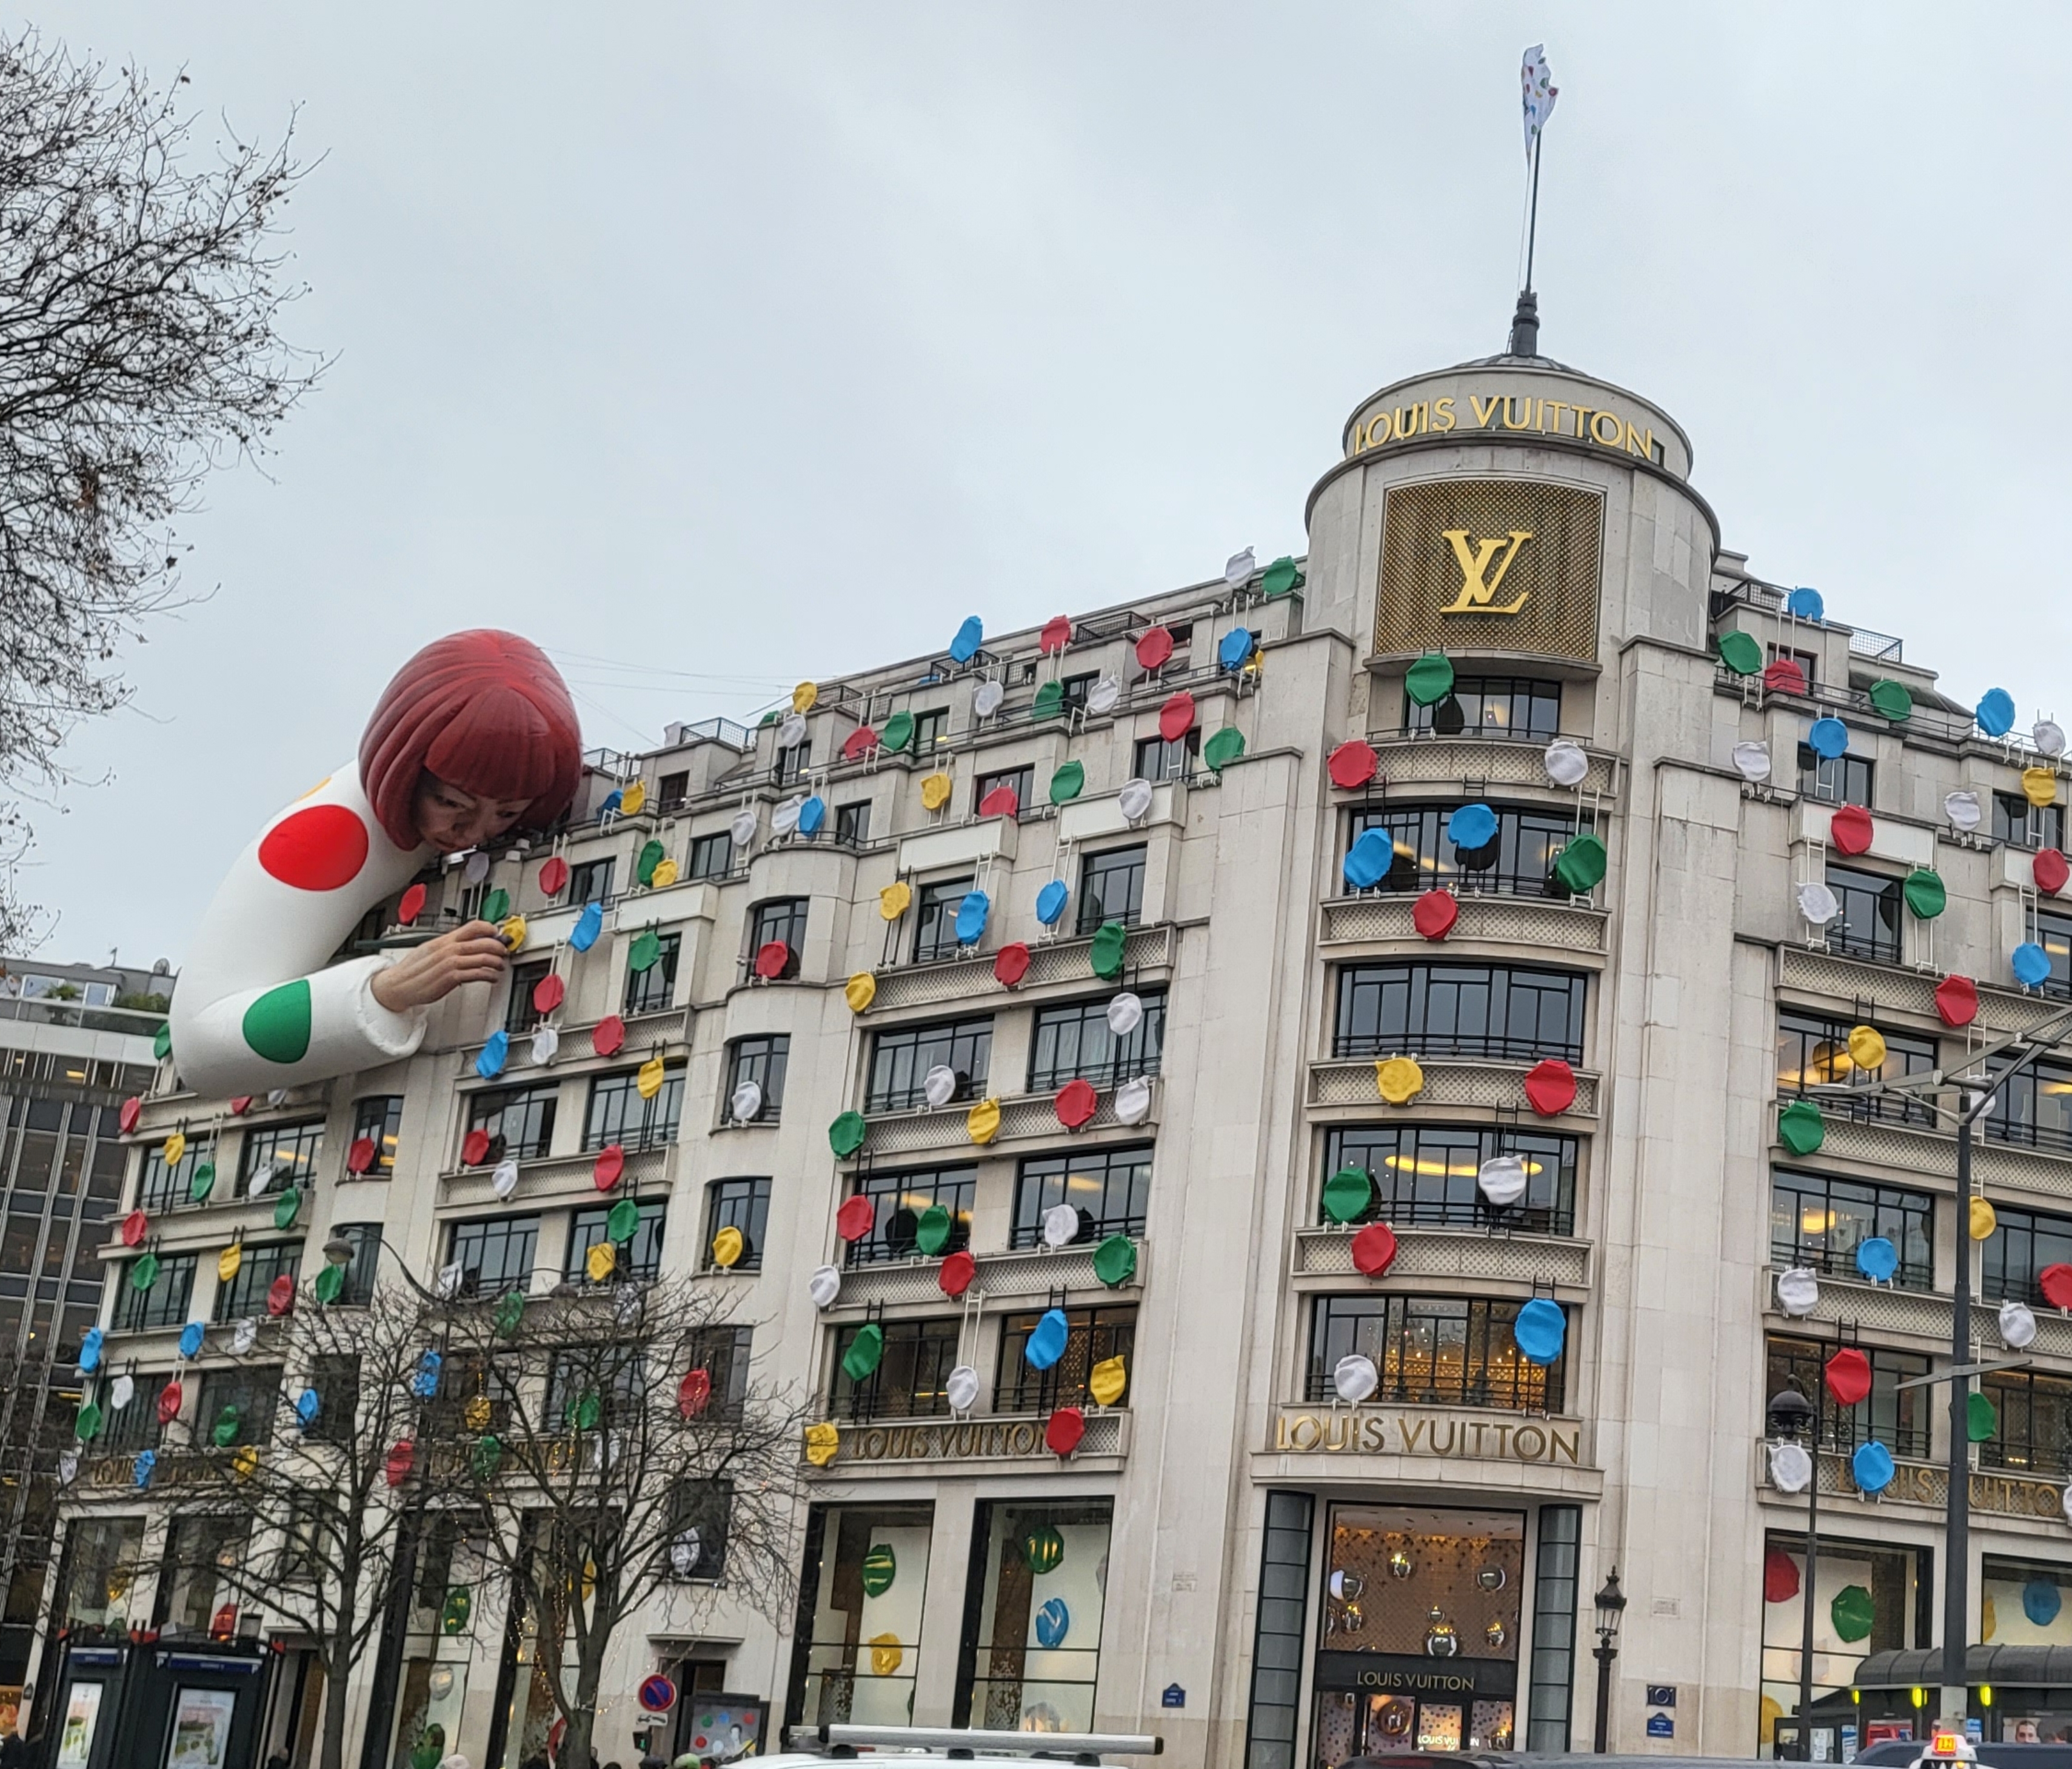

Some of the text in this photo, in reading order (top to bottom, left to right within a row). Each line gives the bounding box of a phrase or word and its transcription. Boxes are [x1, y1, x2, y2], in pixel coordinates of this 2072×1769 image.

[1355, 395, 1653, 461] LOUIS VUITTON
[851, 1426, 929, 1460] LOUIS
[1277, 1415, 1580, 1464] LOUIS VUITTON
[1837, 1459, 2059, 1516] LUIS UITTO
[1357, 1671, 1474, 1690] LOUIS VUITTON
[1417, 1734, 1443, 1744] LOUIS
